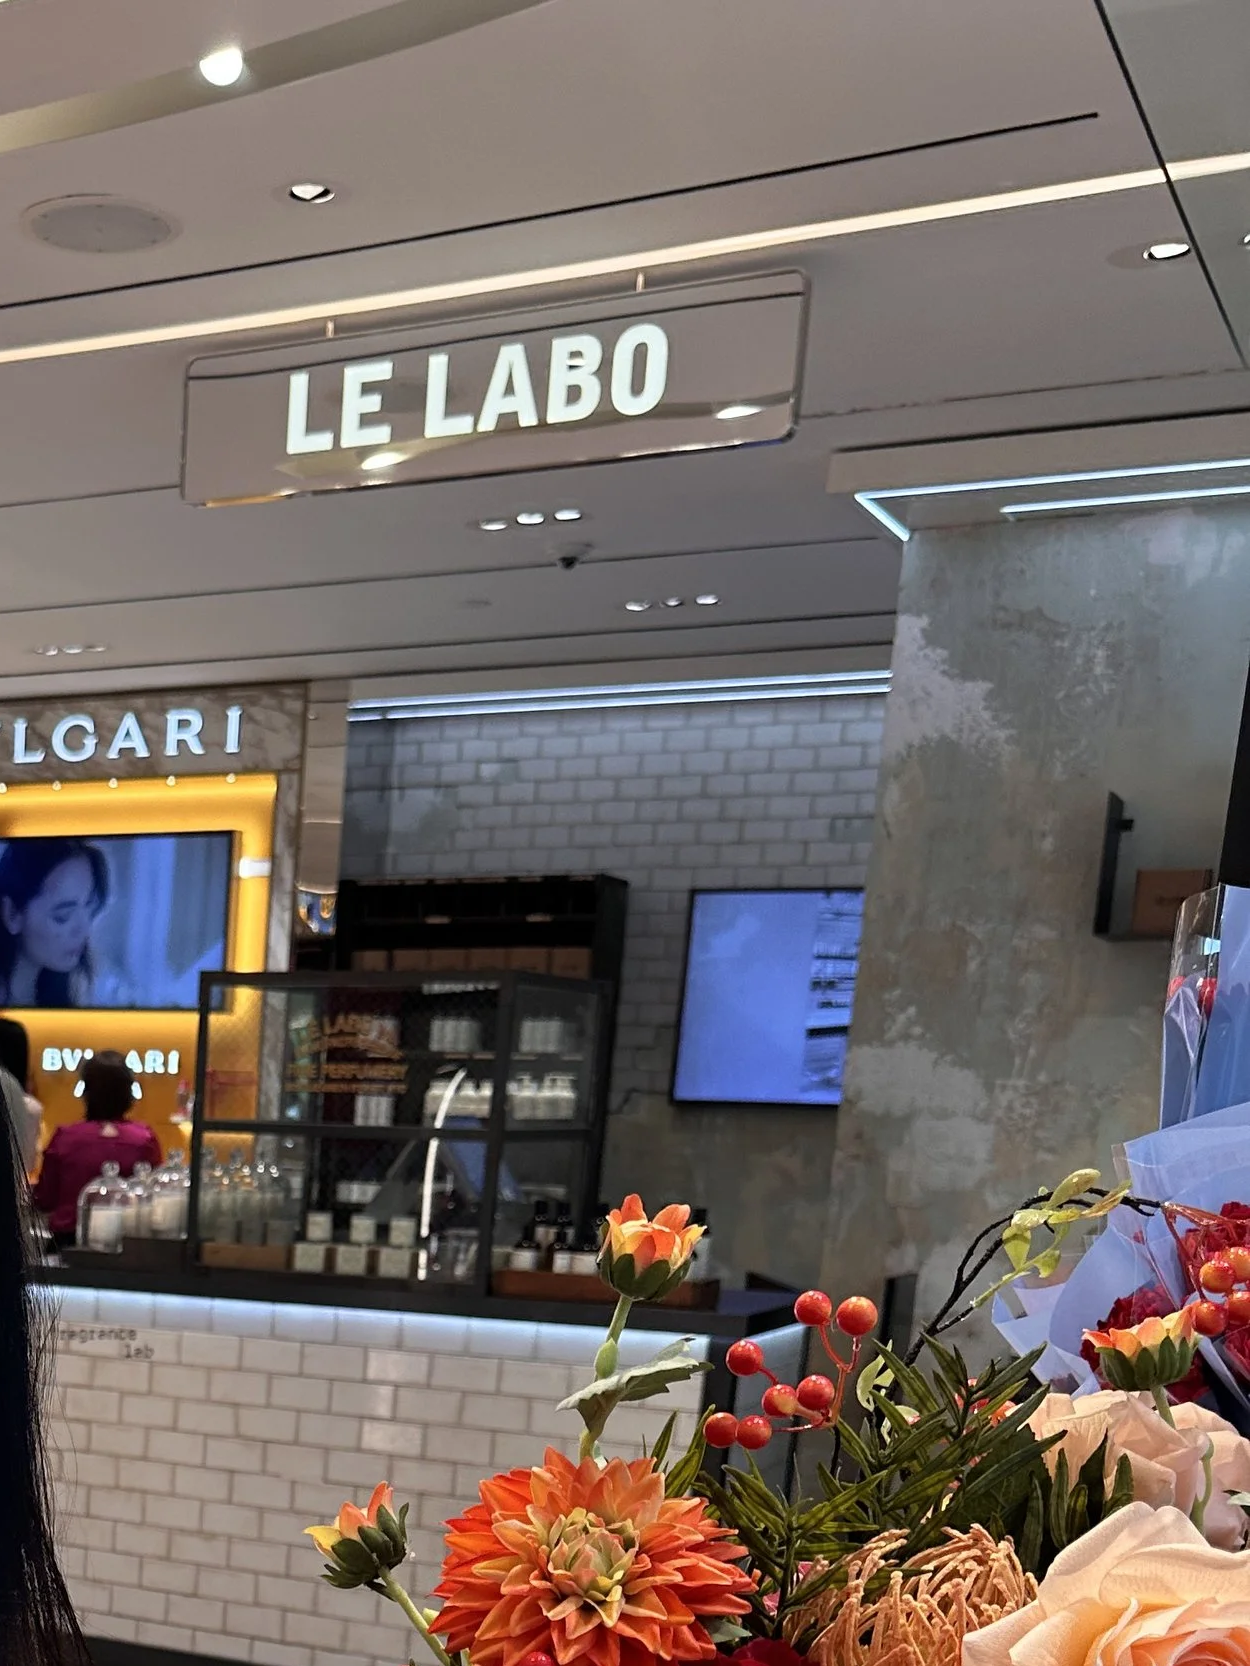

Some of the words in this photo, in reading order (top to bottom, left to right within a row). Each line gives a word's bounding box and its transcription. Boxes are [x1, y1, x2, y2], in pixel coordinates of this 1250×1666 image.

[286, 360, 393, 455] LE
[424, 323, 669, 438] LABO
[42, 1048, 180, 1074] BVARI
[60, 1328, 137, 1343] ragrance
[125, 1343, 155, 1359] lab
